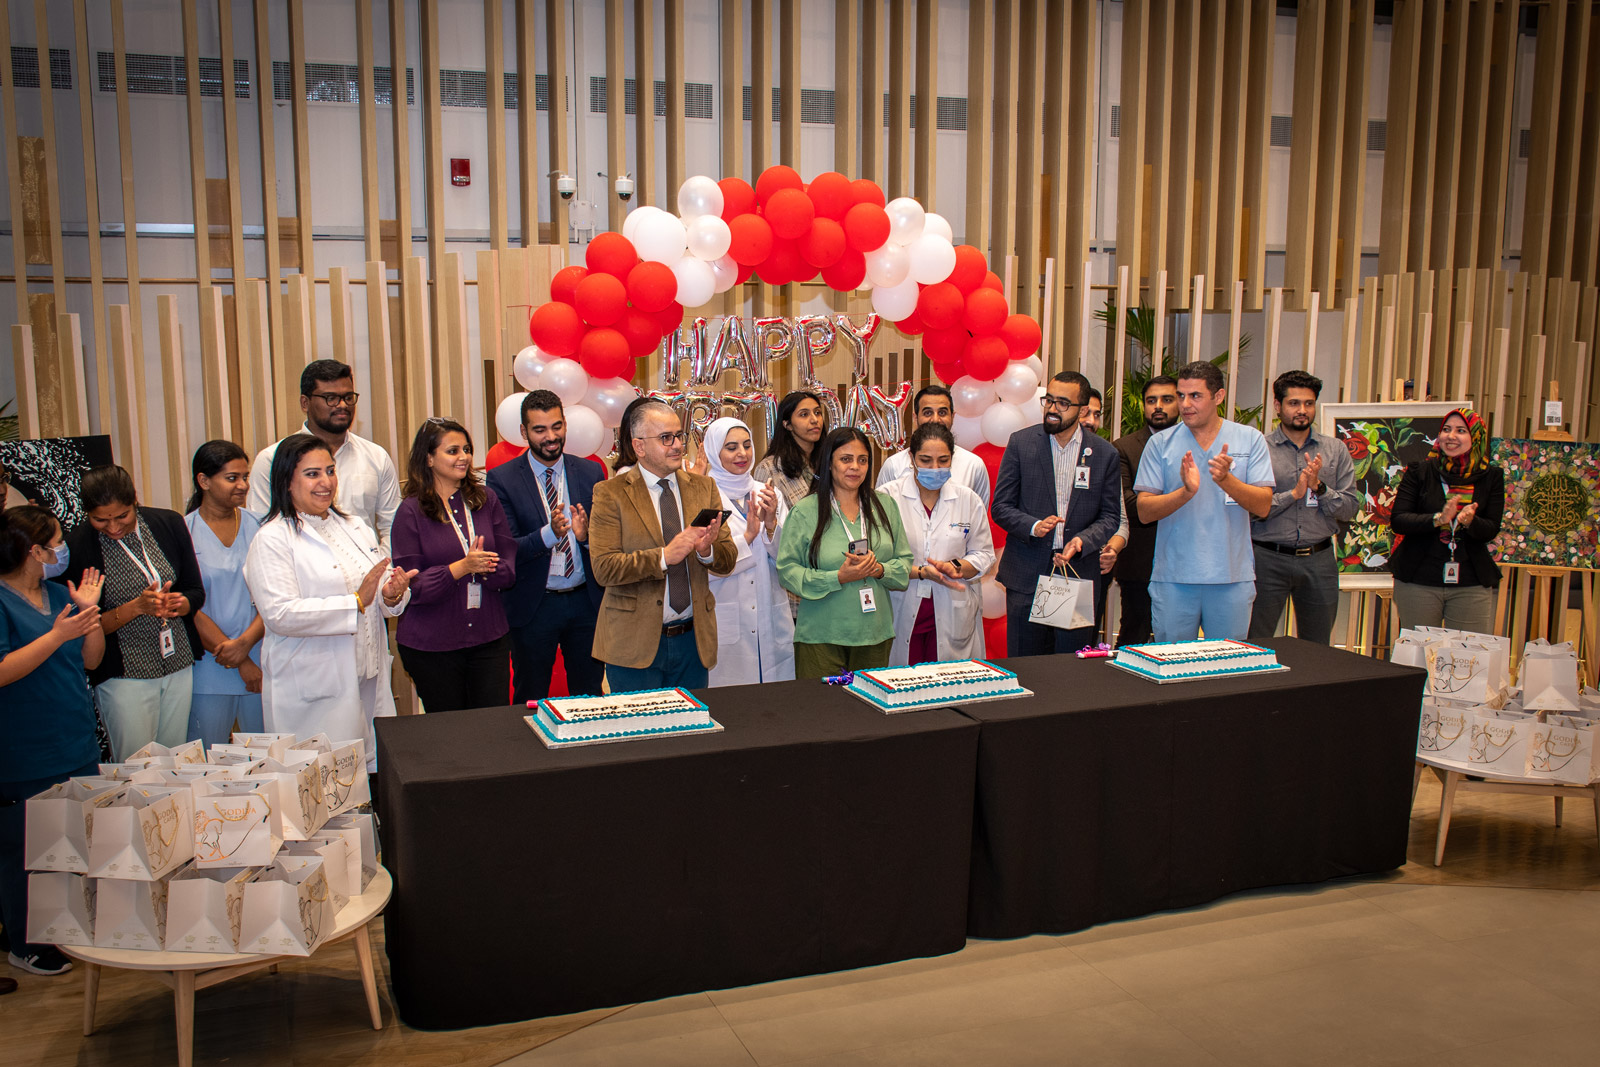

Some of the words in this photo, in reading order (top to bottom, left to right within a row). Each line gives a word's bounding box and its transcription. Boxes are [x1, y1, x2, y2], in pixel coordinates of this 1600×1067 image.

[663, 312, 881, 388] HAPPY
[888, 674, 934, 683] Happy
[936, 669, 991, 677] Birthday
[566, 705, 620, 714] Happy
[624, 699, 686, 708] Birthday
[1553, 735, 1581, 744] GODIA
